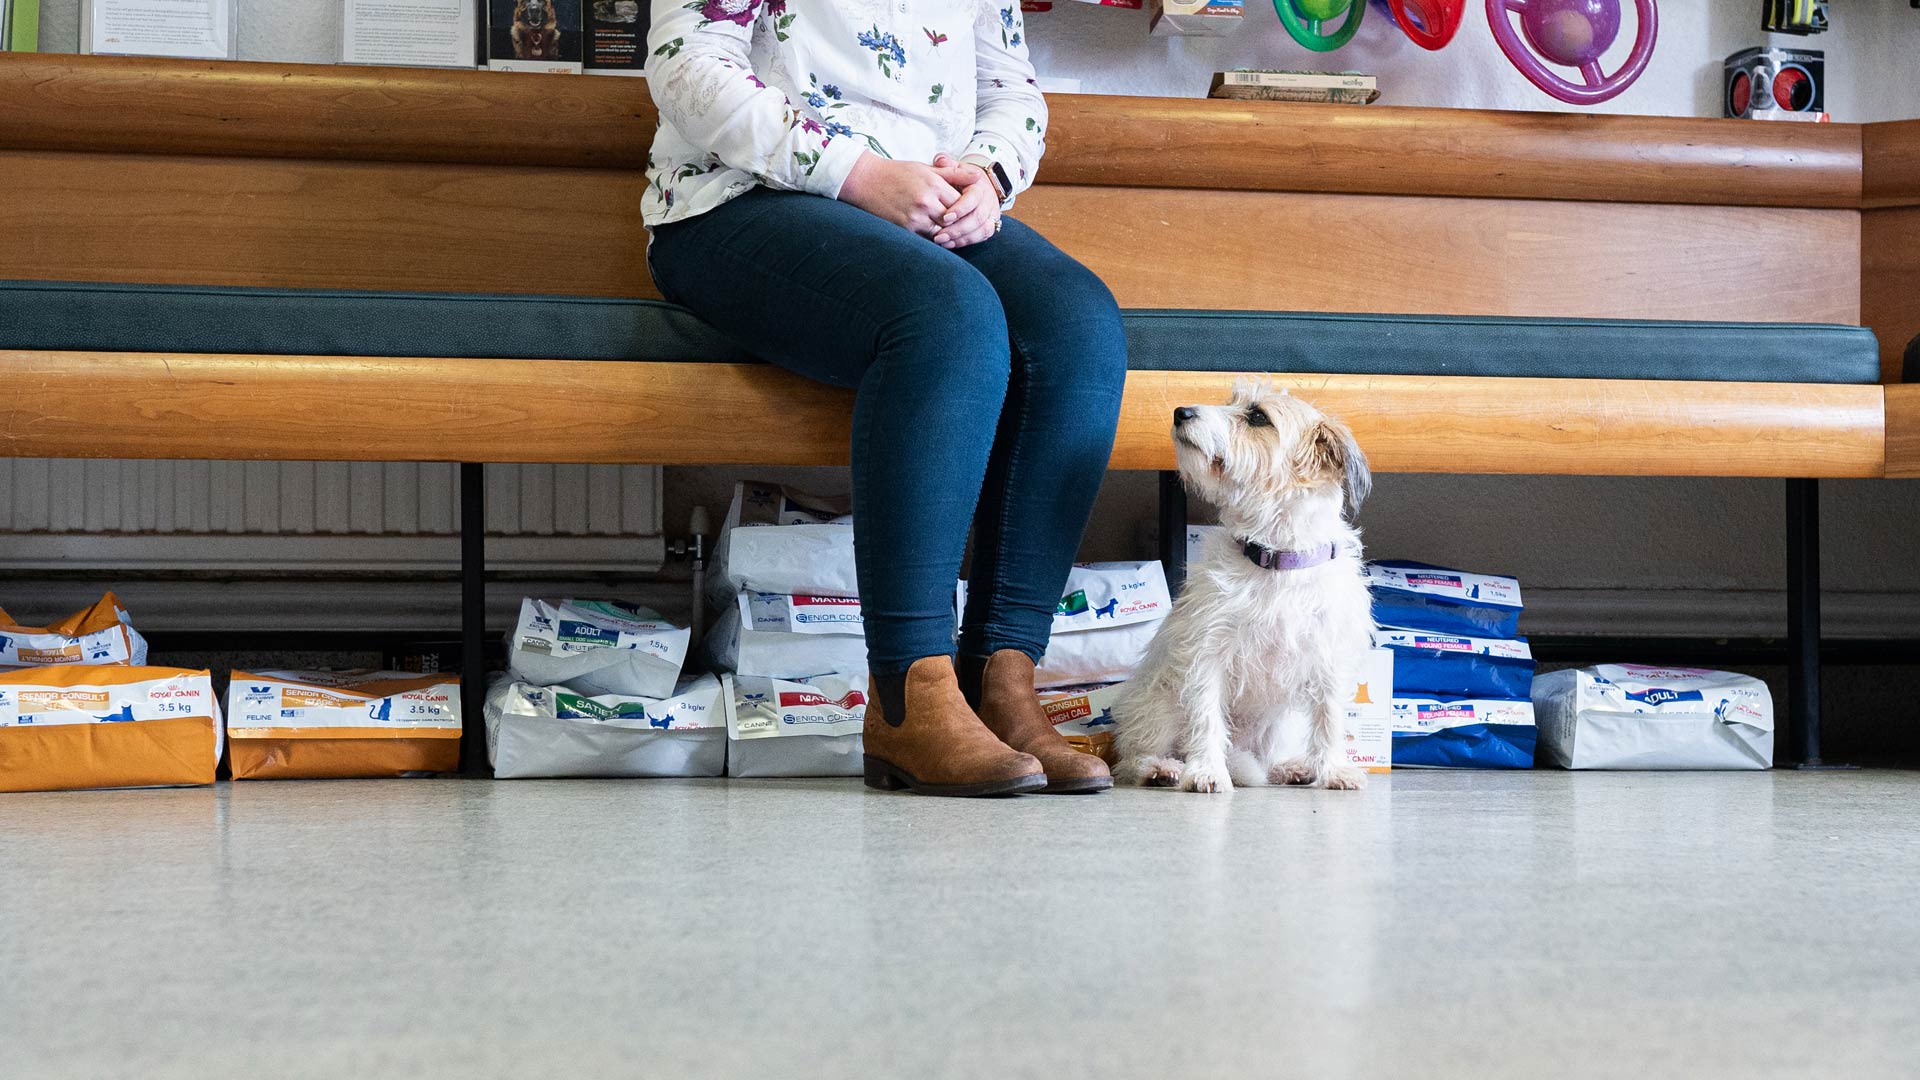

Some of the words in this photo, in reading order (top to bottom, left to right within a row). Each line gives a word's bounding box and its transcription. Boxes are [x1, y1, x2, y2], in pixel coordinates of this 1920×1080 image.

[1120, 606, 1138, 614] ROYAL
[1138, 602, 1158, 611] CANIN
[796, 613, 836, 623] SENIOR
[575, 626, 602, 637] ADULT
[20, 655, 53, 663] CONSULT
[55, 654, 81, 663] SENIOR
[21, 692, 58, 701] SENIOR
[61, 692, 106, 701] CONSULT
[174, 689, 200, 697] CANIN
[285, 689, 320, 698] SENIOR
[402, 693, 424, 701] ROYAL
[425, 694, 449, 702] CANIN
[1644, 690, 1679, 704] ADULT
[158, 703, 175, 712] 3.5
[178, 702, 192, 713] kg
[410, 705, 425, 714] 3.5
[428, 705, 441, 716] kg
[576, 700, 622, 716] SATIETY
[1046, 698, 1085, 713] CONSULT
[783, 714, 825, 725] SENIOR
[827, 713, 865, 722] CONSUL
[1050, 713, 1070, 724] HIGH
[1422, 711, 1445, 719] YOUNG
[744, 721, 773, 729] CANINE
